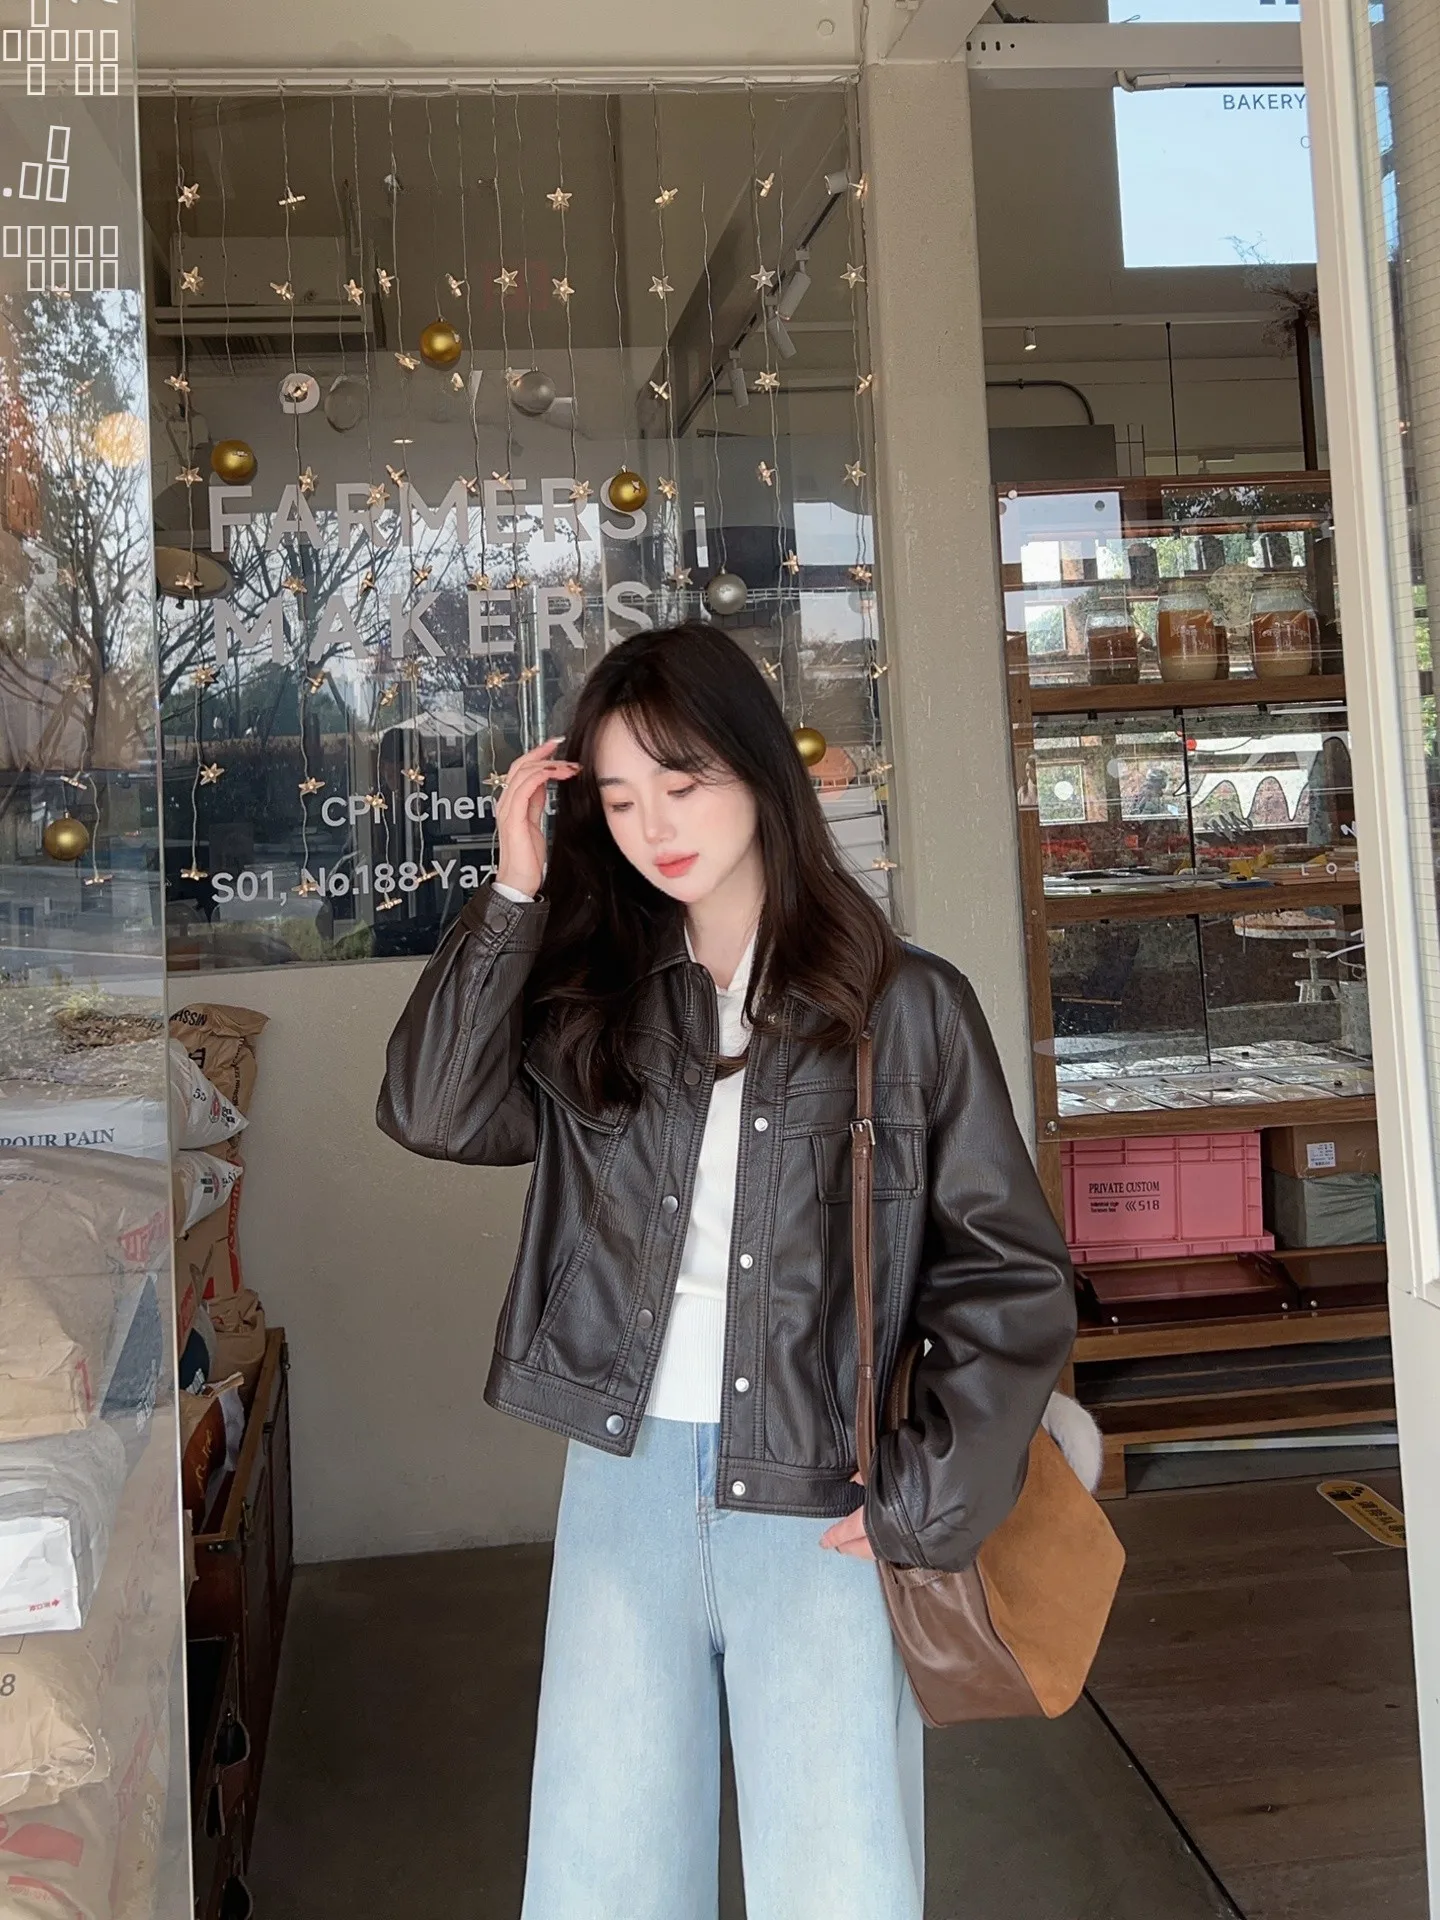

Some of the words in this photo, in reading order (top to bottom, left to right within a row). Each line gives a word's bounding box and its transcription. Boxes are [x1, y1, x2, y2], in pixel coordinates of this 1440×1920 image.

[1223, 94, 1306, 110] BAKERY
[209, 476, 649, 553] FARMERS
[212, 581, 655, 665] MAKERS
[211, 870, 287, 906] S01,
[302, 861, 419, 897] No.188
[64, 1128, 115, 1147] PAIN
[1088, 1182, 1124, 1194] PRIVATE
[1126, 1181, 1160, 1193] CUSTOM
